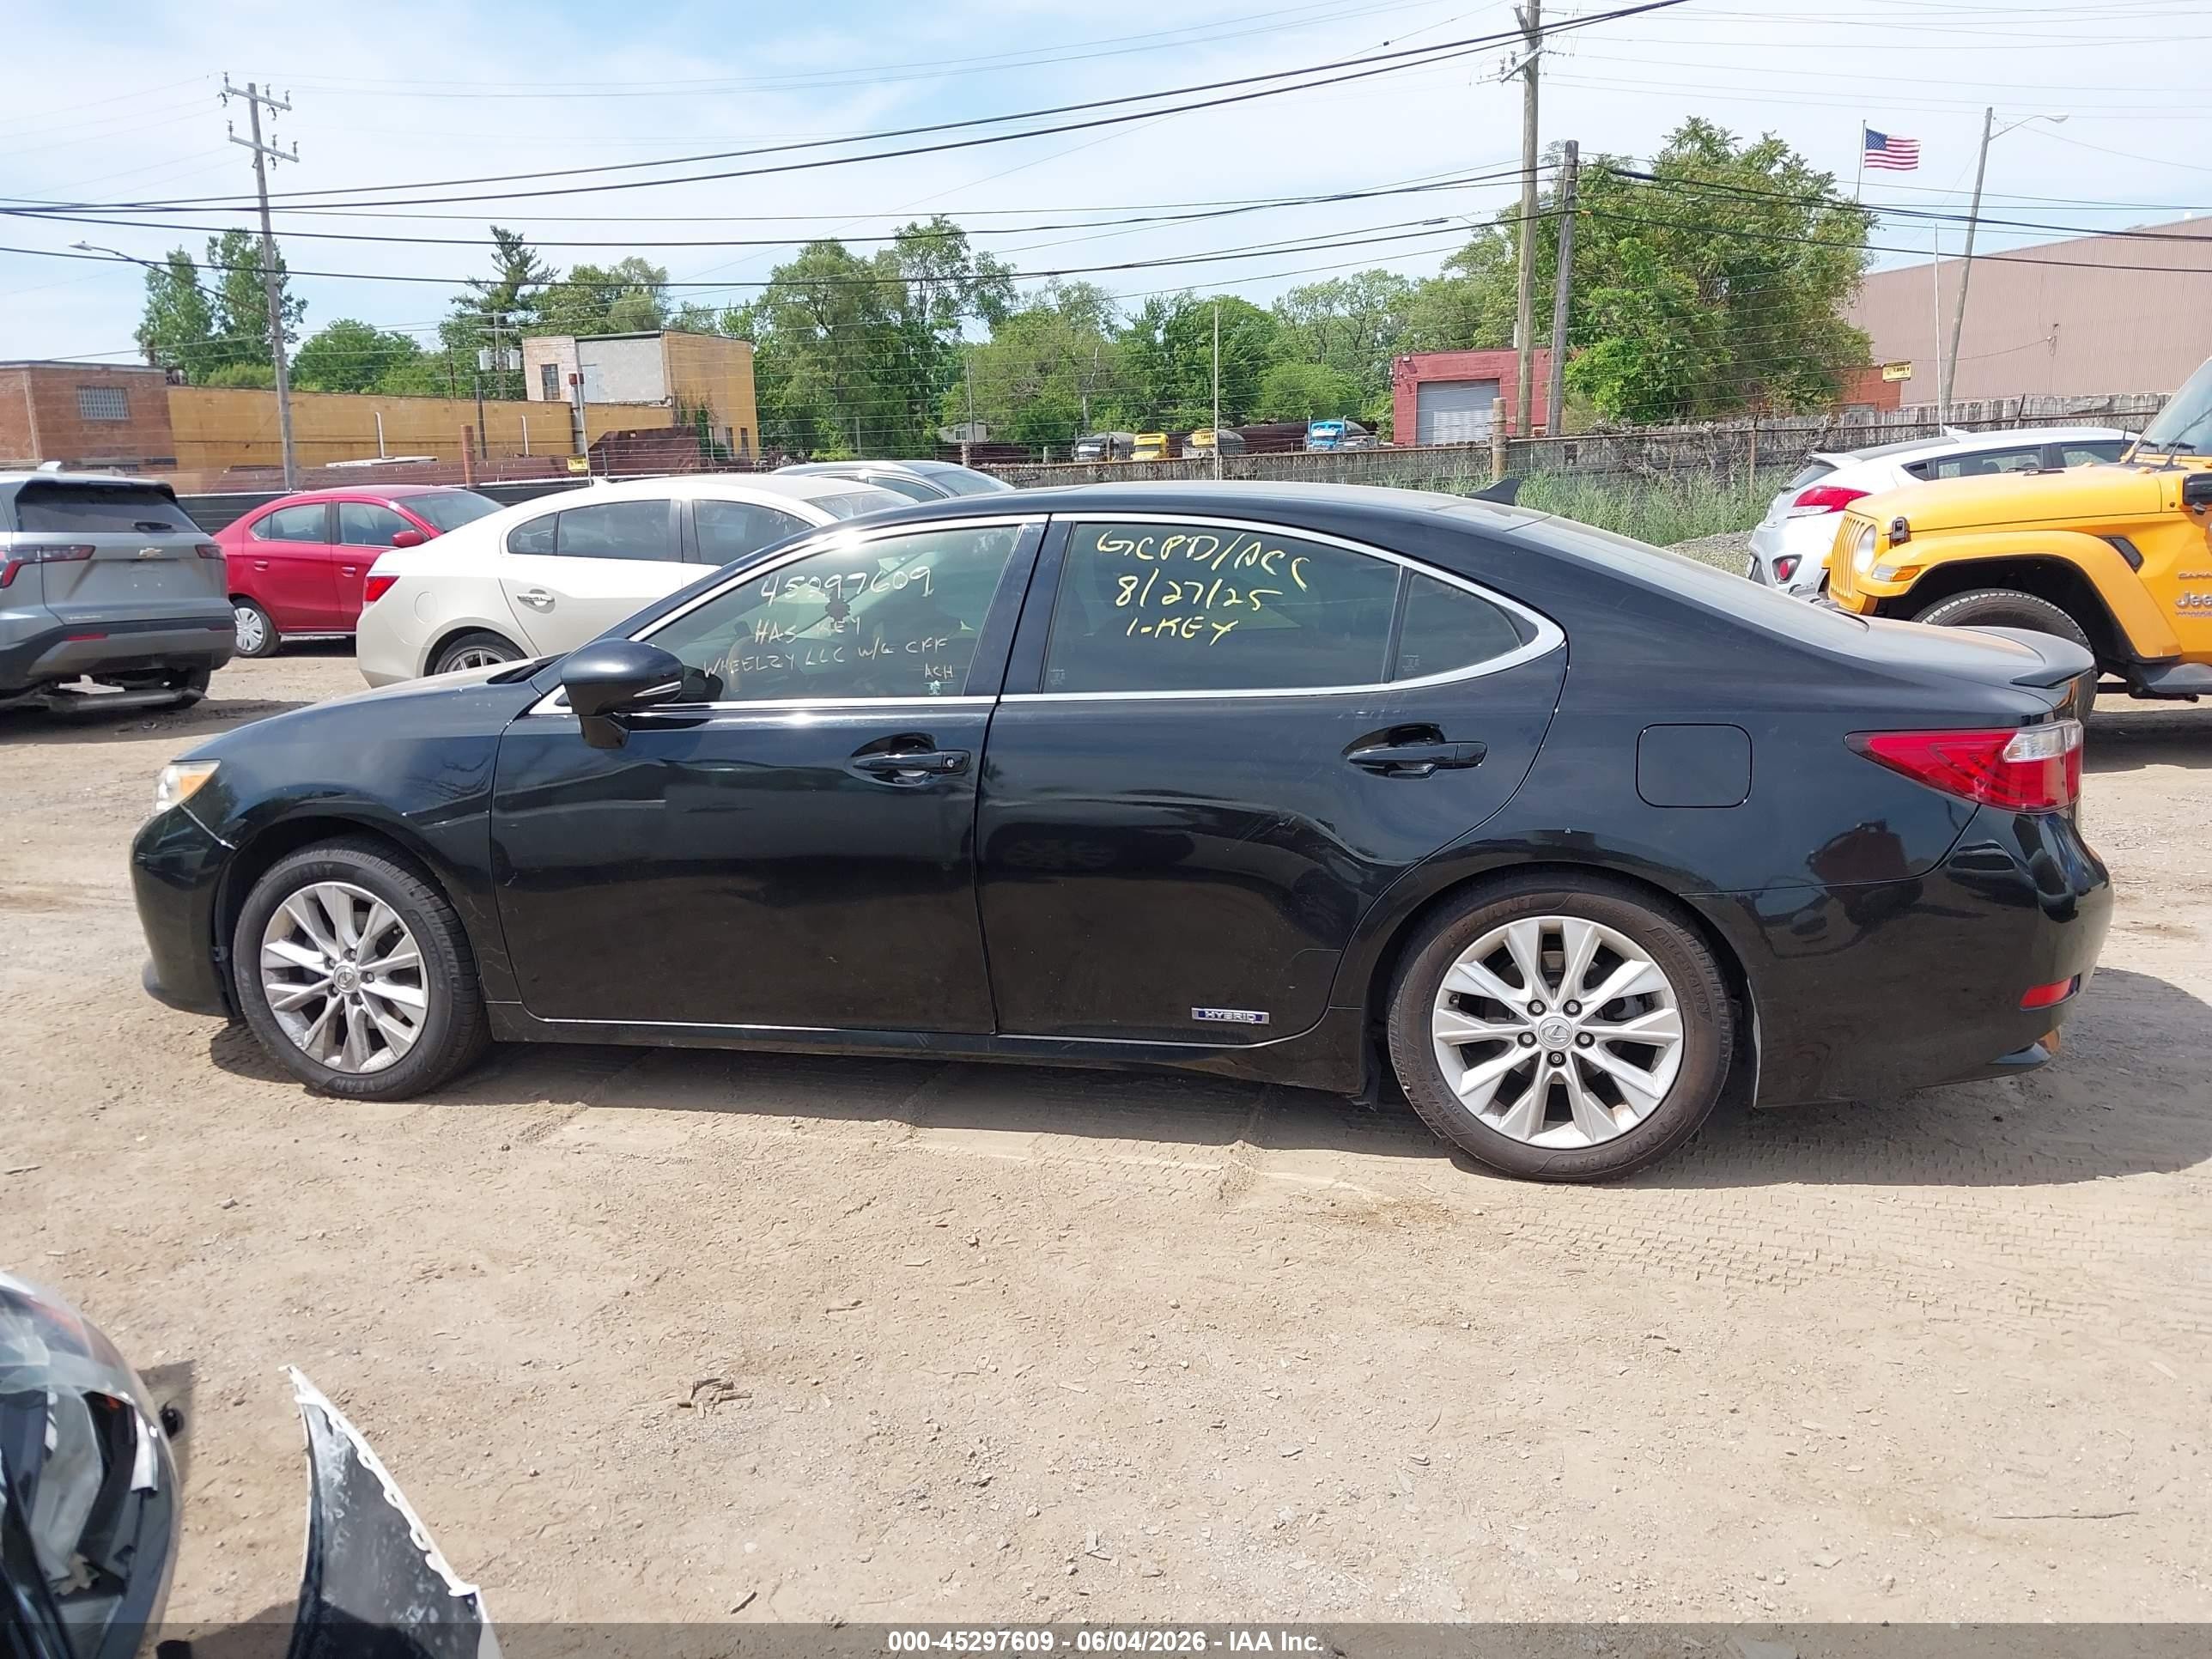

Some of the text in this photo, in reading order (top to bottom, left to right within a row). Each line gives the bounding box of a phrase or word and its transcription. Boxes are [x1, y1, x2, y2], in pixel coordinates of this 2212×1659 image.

[1115, 568, 1284, 611] 8/27/25
[754, 617, 861, 645] HAS KEY
[1126, 616, 1239, 646] 1-KEY
[805, 647, 845, 665] LLC
[1206, 1011, 1256, 1021] HYBRID
